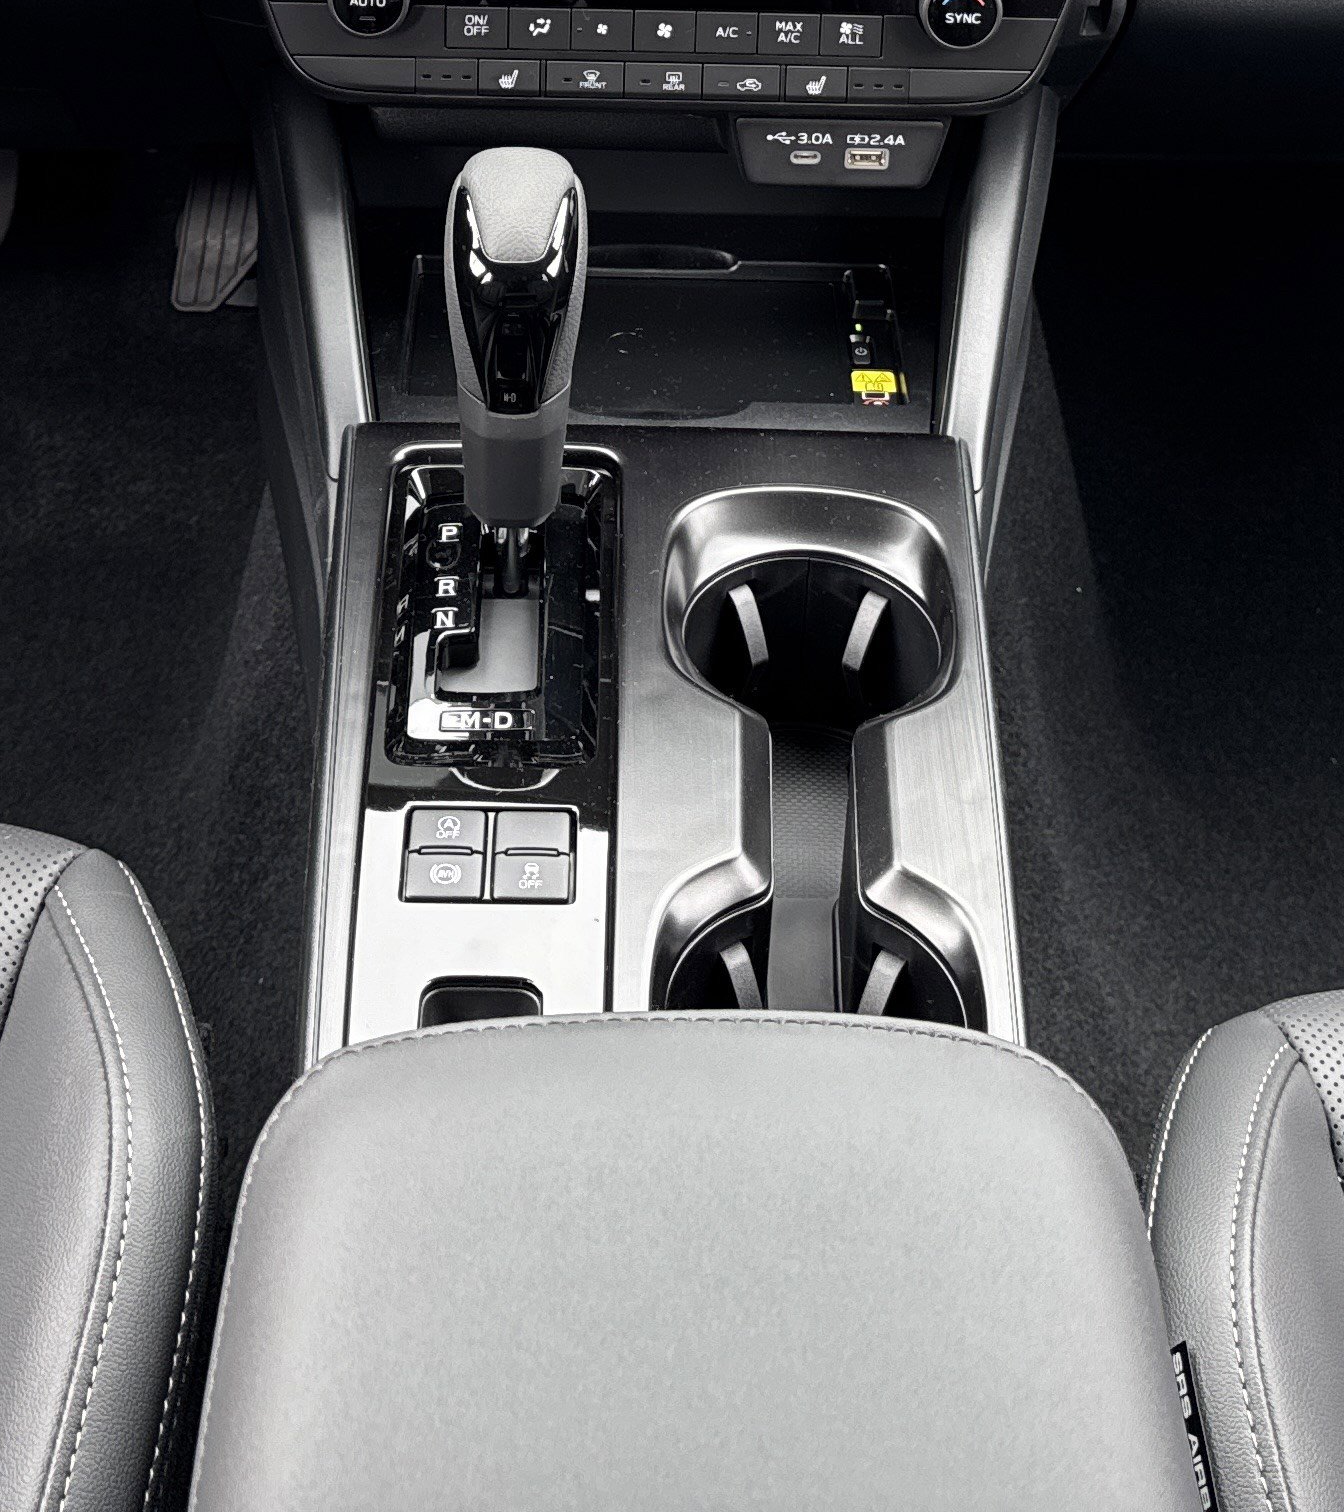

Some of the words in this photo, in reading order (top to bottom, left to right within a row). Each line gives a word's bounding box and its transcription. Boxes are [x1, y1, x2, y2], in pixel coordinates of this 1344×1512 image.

[464, 14, 489, 25] ON/
[944, 12, 982, 25] SYNC
[463, 25, 490, 36] OFF
[715, 26, 739, 39] A/C
[775, 21, 804, 32] MAX
[777, 32, 801, 45] A/C
[838, 33, 865, 46] ALL
[662, 81, 686, 92] REAR
[797, 131, 833, 146] 3.0A
[869, 132, 906, 147] 2.4A
[441, 525, 458, 541] P
[437, 579, 455, 596] R
[435, 611, 454, 627] N
[435, 829, 461, 839] OFF
[518, 879, 543, 889] OFF
[1172, 1351, 1192, 1420] SRS
